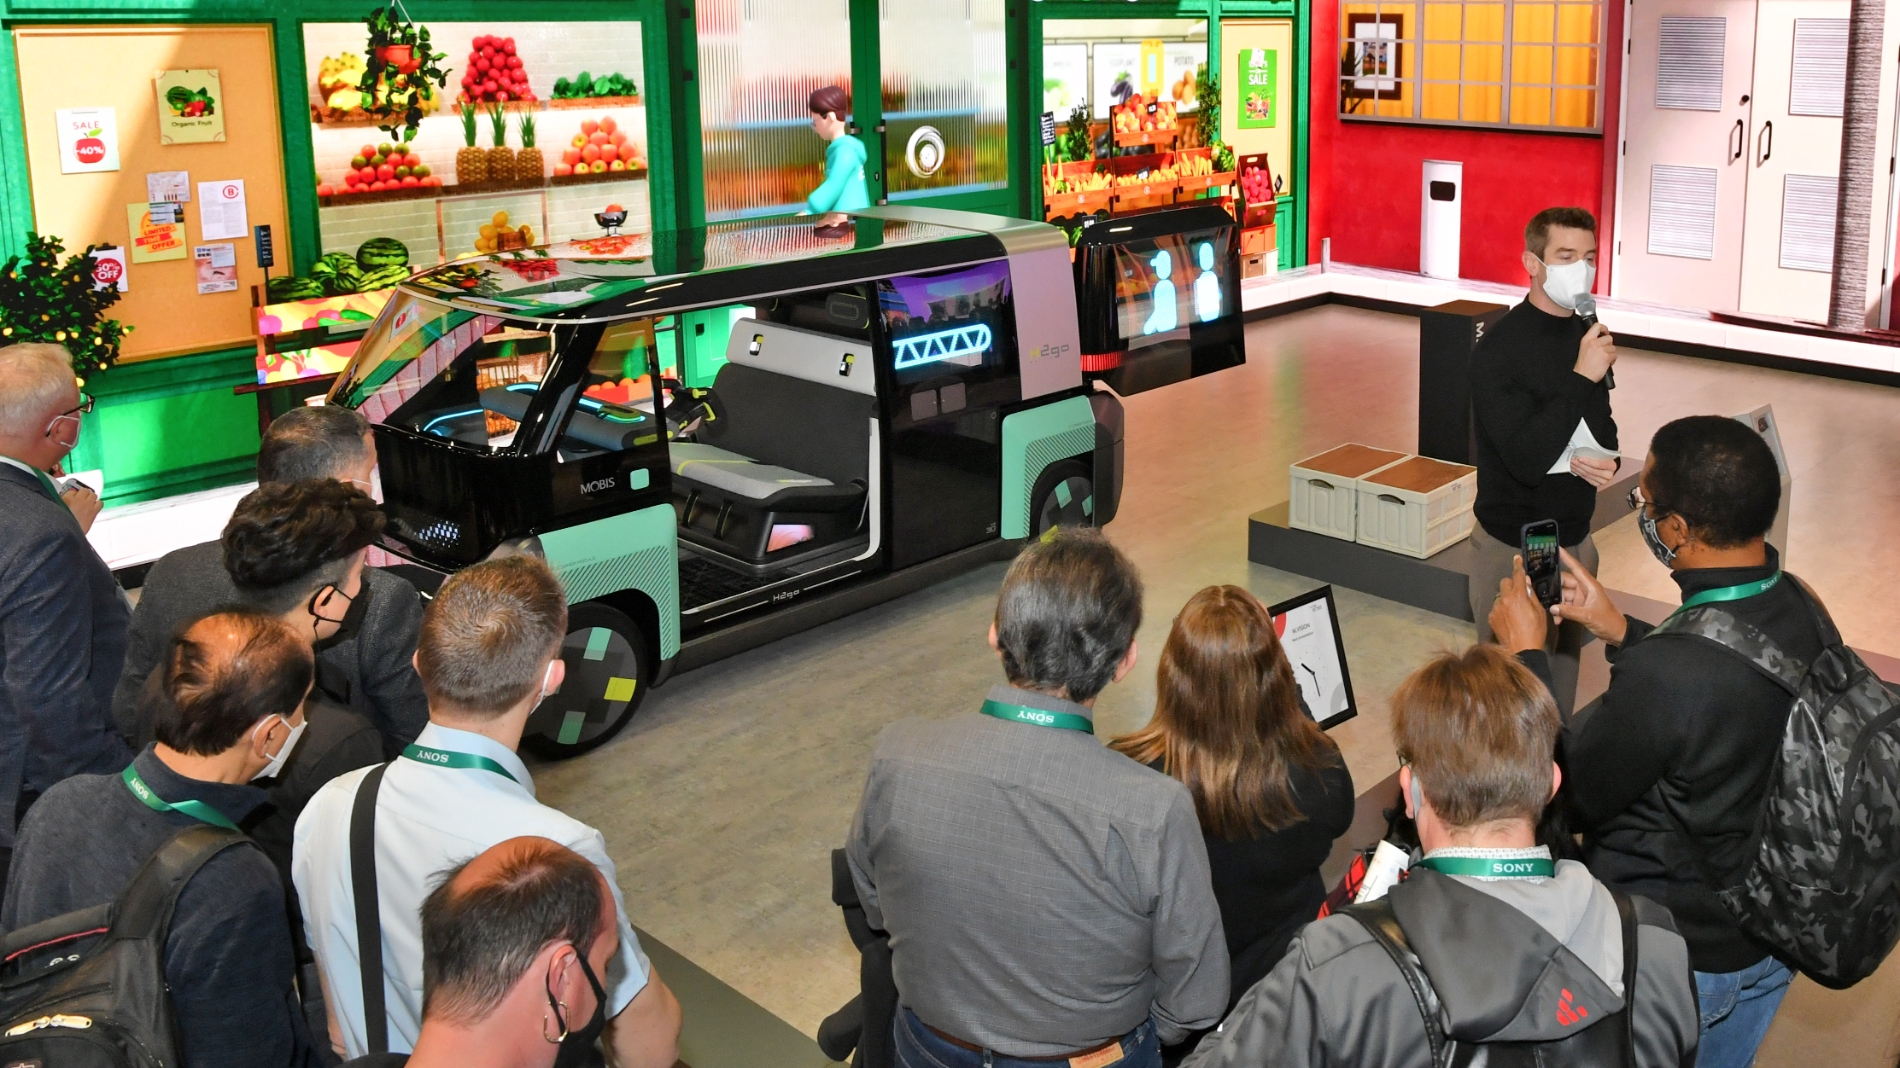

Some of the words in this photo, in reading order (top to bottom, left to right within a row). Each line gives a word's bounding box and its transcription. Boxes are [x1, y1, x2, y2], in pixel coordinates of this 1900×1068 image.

[1174, 56, 1194, 66] POTATO
[1248, 73, 1268, 85] SALE
[72, 120, 100, 130] SALE
[143, 225, 172, 236] LIMITED
[143, 234, 162, 245] TIME
[151, 239, 176, 250] OFFER
[97, 270, 119, 280] OFF
[580, 476, 616, 495] MOBIS
[1760, 574, 1779, 591] SONY
[773, 589, 800, 601] H2go
[1017, 710, 1055, 724] SONY
[416, 750, 450, 763] SONY
[130, 777, 150, 800] SONY
[1492, 862, 1535, 874] SONY
